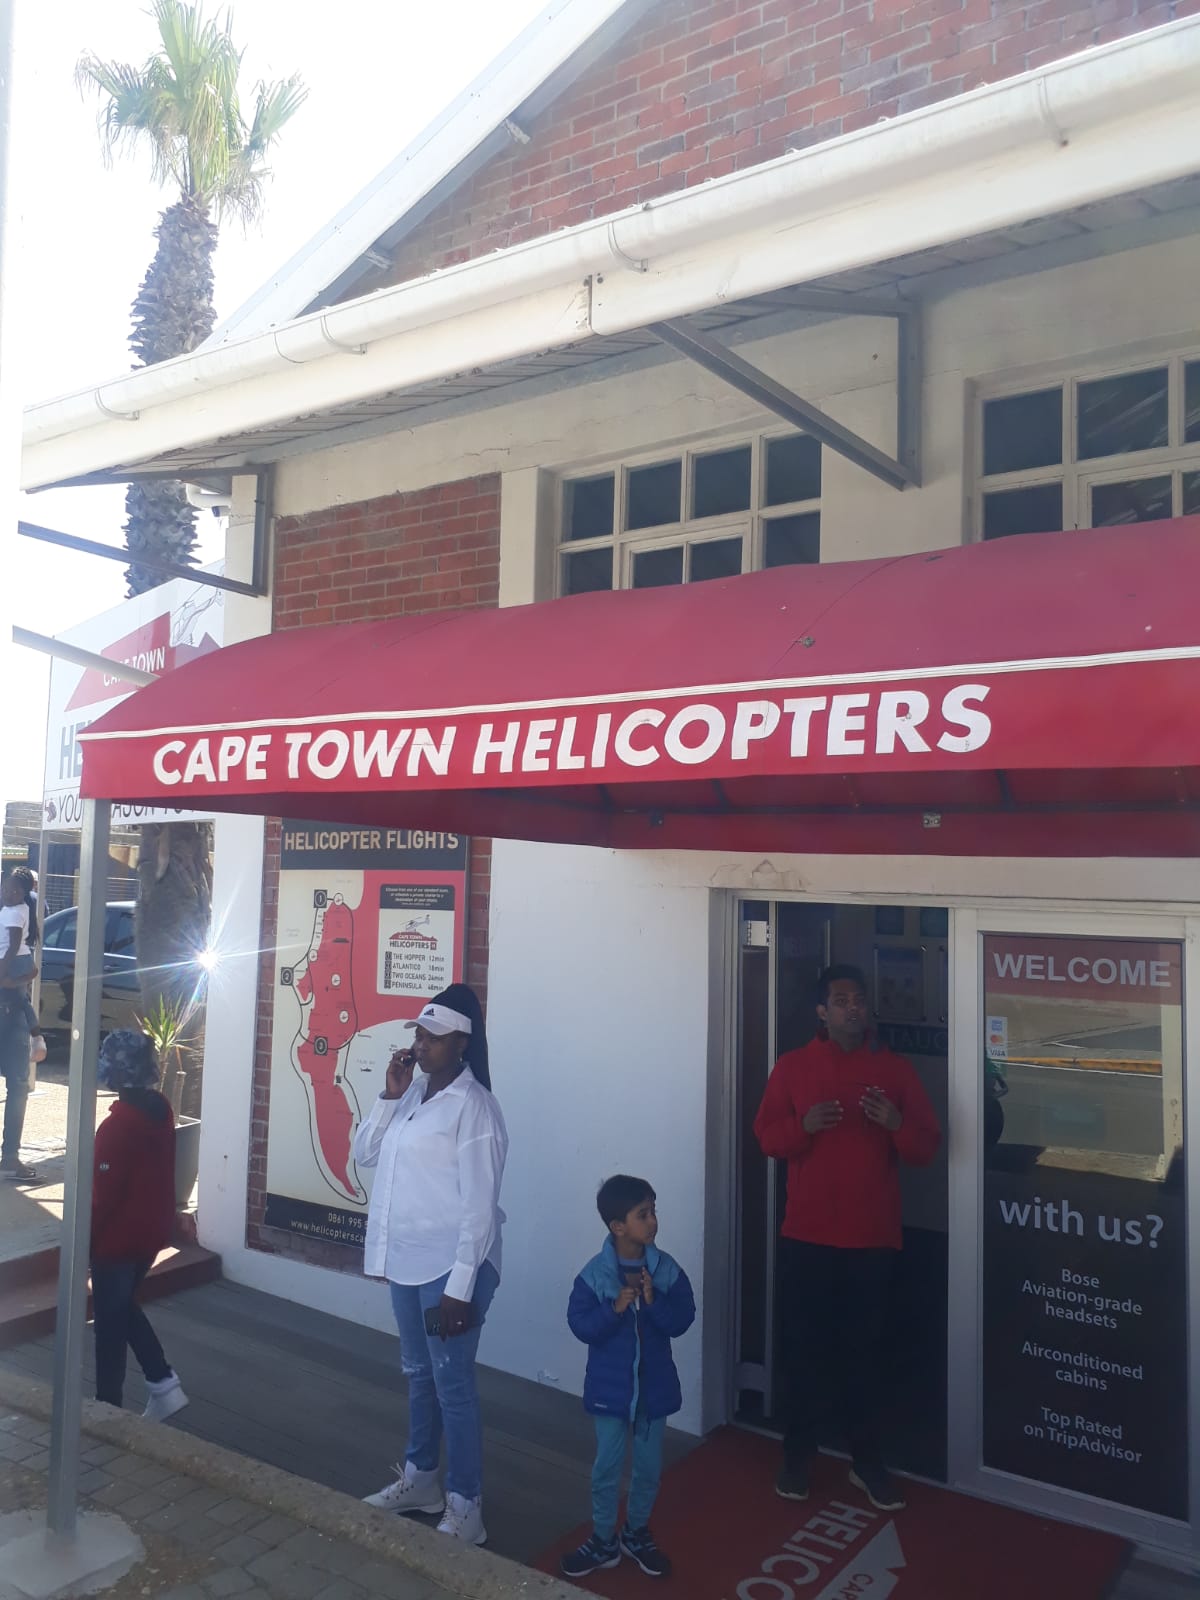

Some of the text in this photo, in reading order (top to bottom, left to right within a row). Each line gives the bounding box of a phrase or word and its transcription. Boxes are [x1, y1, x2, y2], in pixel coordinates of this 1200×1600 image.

[153, 683, 992, 785] CAPE TOWN HELICOPTERS
[284, 829, 459, 851] HELICOPTER FLIGHTS
[389, 940, 430, 949] HELICOPTERS
[392, 962, 421, 971] ATLANTICO
[393, 952, 445, 962] THE HOPPER 12min
[392, 971, 404, 979] TWO
[404, 972, 427, 981] OCEANS
[992, 951, 1172, 988] WELCOME
[391, 981, 422, 990] PENINSULA
[989, 1048, 1006, 1057] VISA
[328, 1211, 345, 1225] 0861
[348, 1217, 362, 1229] 995
[999, 1196, 1164, 1249] with us?
[1061, 1267, 1100, 1289] Bose
[1021, 1279, 1143, 1316] Aviation-grade
[1045, 1301, 1118, 1330] headsets
[1021, 1341, 1143, 1380] Airconditioned
[1055, 1366, 1108, 1391] cabins
[1041, 1406, 1123, 1440] Top Rated
[1023, 1422, 1143, 1464] on TripAdvisor
